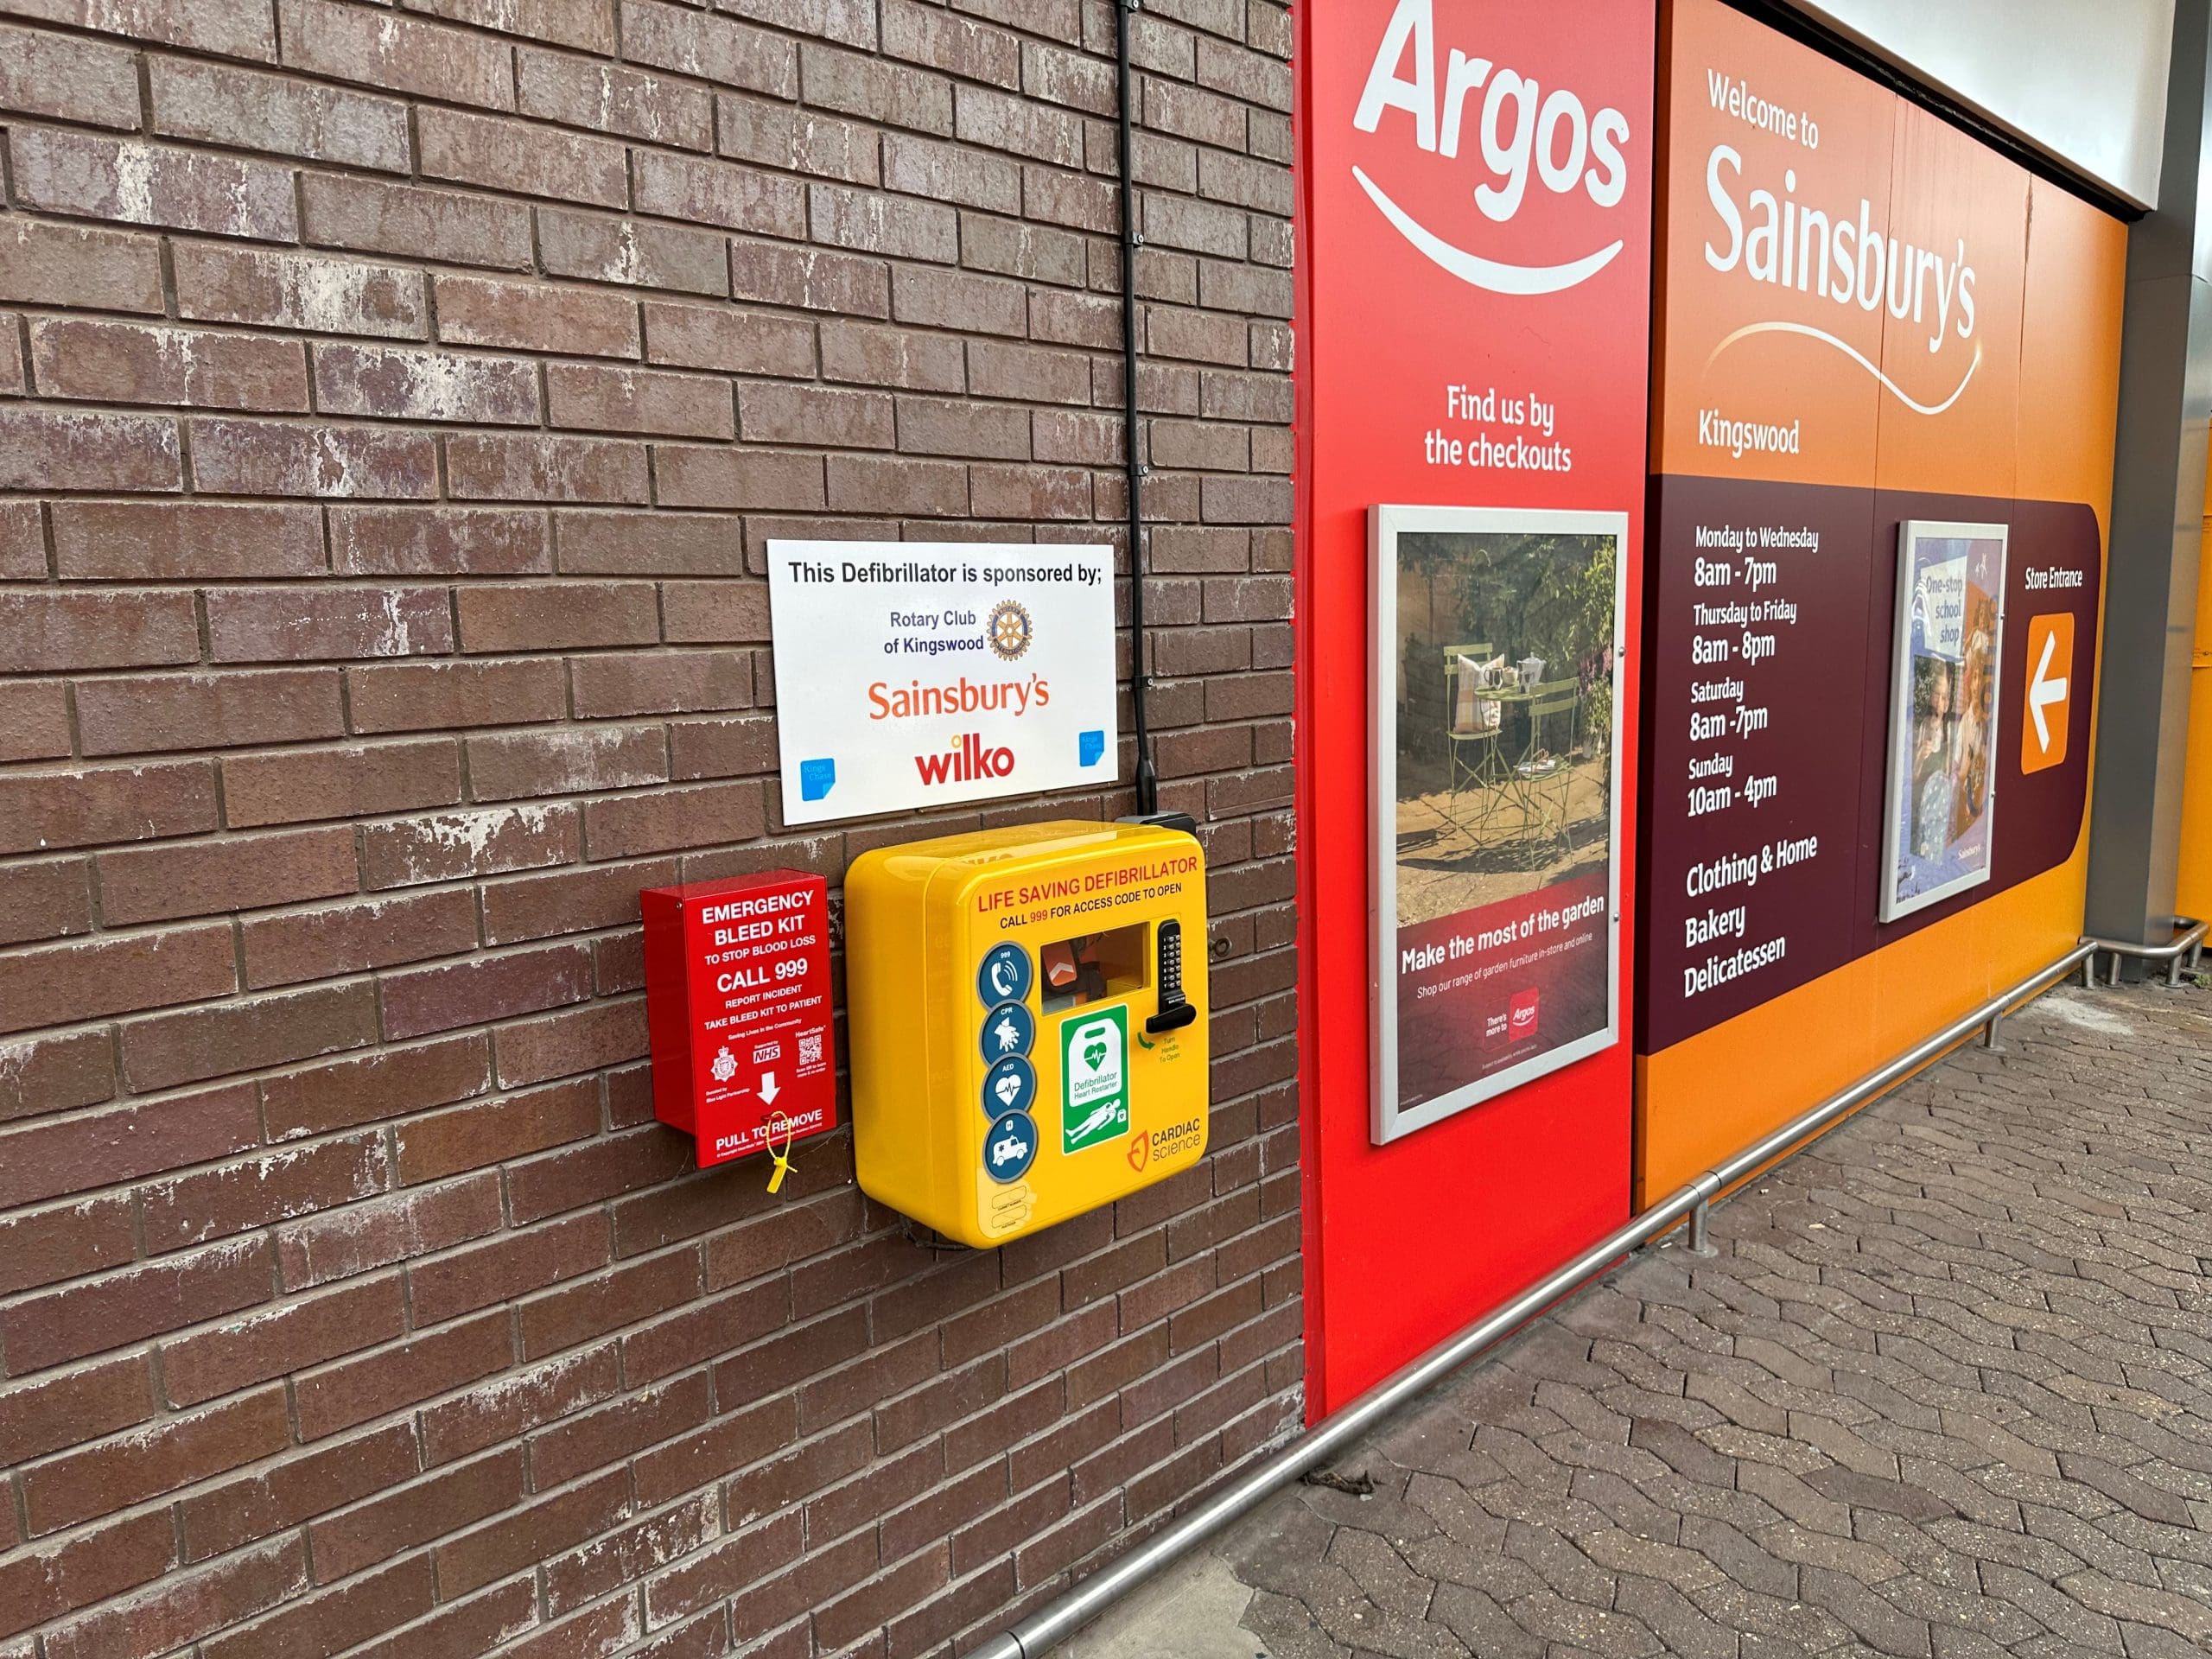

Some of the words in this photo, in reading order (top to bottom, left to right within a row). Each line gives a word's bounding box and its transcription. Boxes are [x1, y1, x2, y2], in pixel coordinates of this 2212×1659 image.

[1353, 0, 1630, 222] Argos
[1707, 68, 1796, 141] Welcome
[1800, 111, 1819, 150] to
[1705, 144, 1976, 353] Sainsbury's
[1447, 385, 1496, 423] Find
[1502, 396, 1524, 426] us
[1529, 394, 1554, 436] by
[1698, 409, 1800, 459] Kingswood
[1425, 429, 1462, 466] the
[1468, 433, 1572, 472] checkouts
[1696, 524, 1744, 554] Monday
[1745, 528, 1758, 548] to
[1759, 526, 1819, 553] Wednesday
[789, 562, 835, 583] This
[842, 562, 956, 583] Defibrillator
[963, 563, 977, 583] is
[983, 563, 1072, 587] sponsored
[1078, 563, 1102, 585] by;
[1694, 557, 1731, 587] 8am
[1744, 556, 1777, 592] 7pm
[1926, 575, 1962, 597] One-stop
[2025, 567, 2048, 589] Store
[2049, 567, 2082, 588] Entrance
[890, 611, 939, 630] Rotary
[944, 610, 976, 626] Club
[1694, 601, 1748, 628] Thursday
[1751, 601, 1762, 622] to
[1764, 599, 1797, 624] Friday
[1936, 600, 1961, 620] school
[884, 639, 899, 653] of
[904, 635, 984, 656] Kingswood
[1693, 635, 1728, 664] 8am
[1742, 631, 1776, 666] 8pm
[1940, 625, 1959, 646] shop
[868, 673, 1050, 720] Sainsbury's
[1691, 677, 1744, 703] Saturday
[1690, 712, 1726, 741] 8am
[914, 733, 1014, 785] wilko
[1688, 753, 1733, 779] Sunday
[1688, 786, 1731, 817] 10am
[1744, 774, 1777, 808] 4pm
[1687, 853, 1758, 898] Clothing
[1761, 844, 1773, 874] &
[1776, 836, 1818, 869] Home
[978, 889, 1014, 912] LIFE
[1019, 878, 1080, 906] SAVING
[1084, 856, 1198, 892] DEFIBRILLATOR
[702, 890, 814, 925] EMERGENCY
[1000, 914, 1027, 930] CALL
[1030, 910, 1048, 923] 999
[1051, 905, 1071, 918] FOR
[1073, 898, 1113, 914] ACCESS
[1115, 891, 1141, 906] CODE
[1143, 888, 1155, 899] TO
[1158, 882, 1182, 897] OPEN
[715, 920, 773, 946] BLEED
[778, 914, 805, 933] KIT
[1402, 944, 1445, 974] Make
[1449, 935, 1475, 960] the
[1478, 923, 1517, 951] most
[1520, 916, 1535, 938] of
[1537, 909, 1560, 932] the
[1562, 895, 1605, 931] garden
[1685, 906, 1745, 949] Bakery
[705, 954, 720, 965] TO
[721, 948, 750, 963] STOP
[752, 940, 788, 957] BLOOD
[791, 935, 817, 949] LOSS
[1417, 983, 1437, 999] Shop
[1439, 978, 1451, 991] our
[1452, 972, 1473, 988] range
[1474, 967, 1483, 980] of
[1483, 961, 1508, 978] garden
[1510, 950, 1538, 969] furniture
[1538, 944, 1563, 960] in-store
[1564, 938, 1575, 951] and
[1575, 931, 1592, 948] online
[716, 966, 771, 993] CALL
[774, 957, 808, 982] 999
[1684, 936, 1785, 998] Delicatessen
[704, 1017, 728, 1030] TAKE
[729, 1010, 758, 1027] BLEED
[760, 1007, 774, 1019] KIT
[776, 1004, 787, 1014] TO
[789, 995, 823, 1011] PATIENT
[725, 994, 760, 1009] REPORT
[762, 984, 802, 1001] INCIDENT
[1001, 1007, 1013, 1015] CPR
[1513, 1006, 1535, 1021] Argos
[1485, 1026, 1501, 1037] more
[1501, 1023, 1507, 1032] to
[754, 1047, 779, 1062] NHS
[1002, 1063, 1014, 1071] AED
[1074, 1071, 1117, 1092] Defibrillator
[1074, 1089, 1090, 1100] Heart
[715, 1131, 749, 1151] PULL
[752, 1126, 768, 1140] TO
[772, 1109, 823, 1134] REMOVE
[1152, 1118, 1200, 1147] CARDIAC
